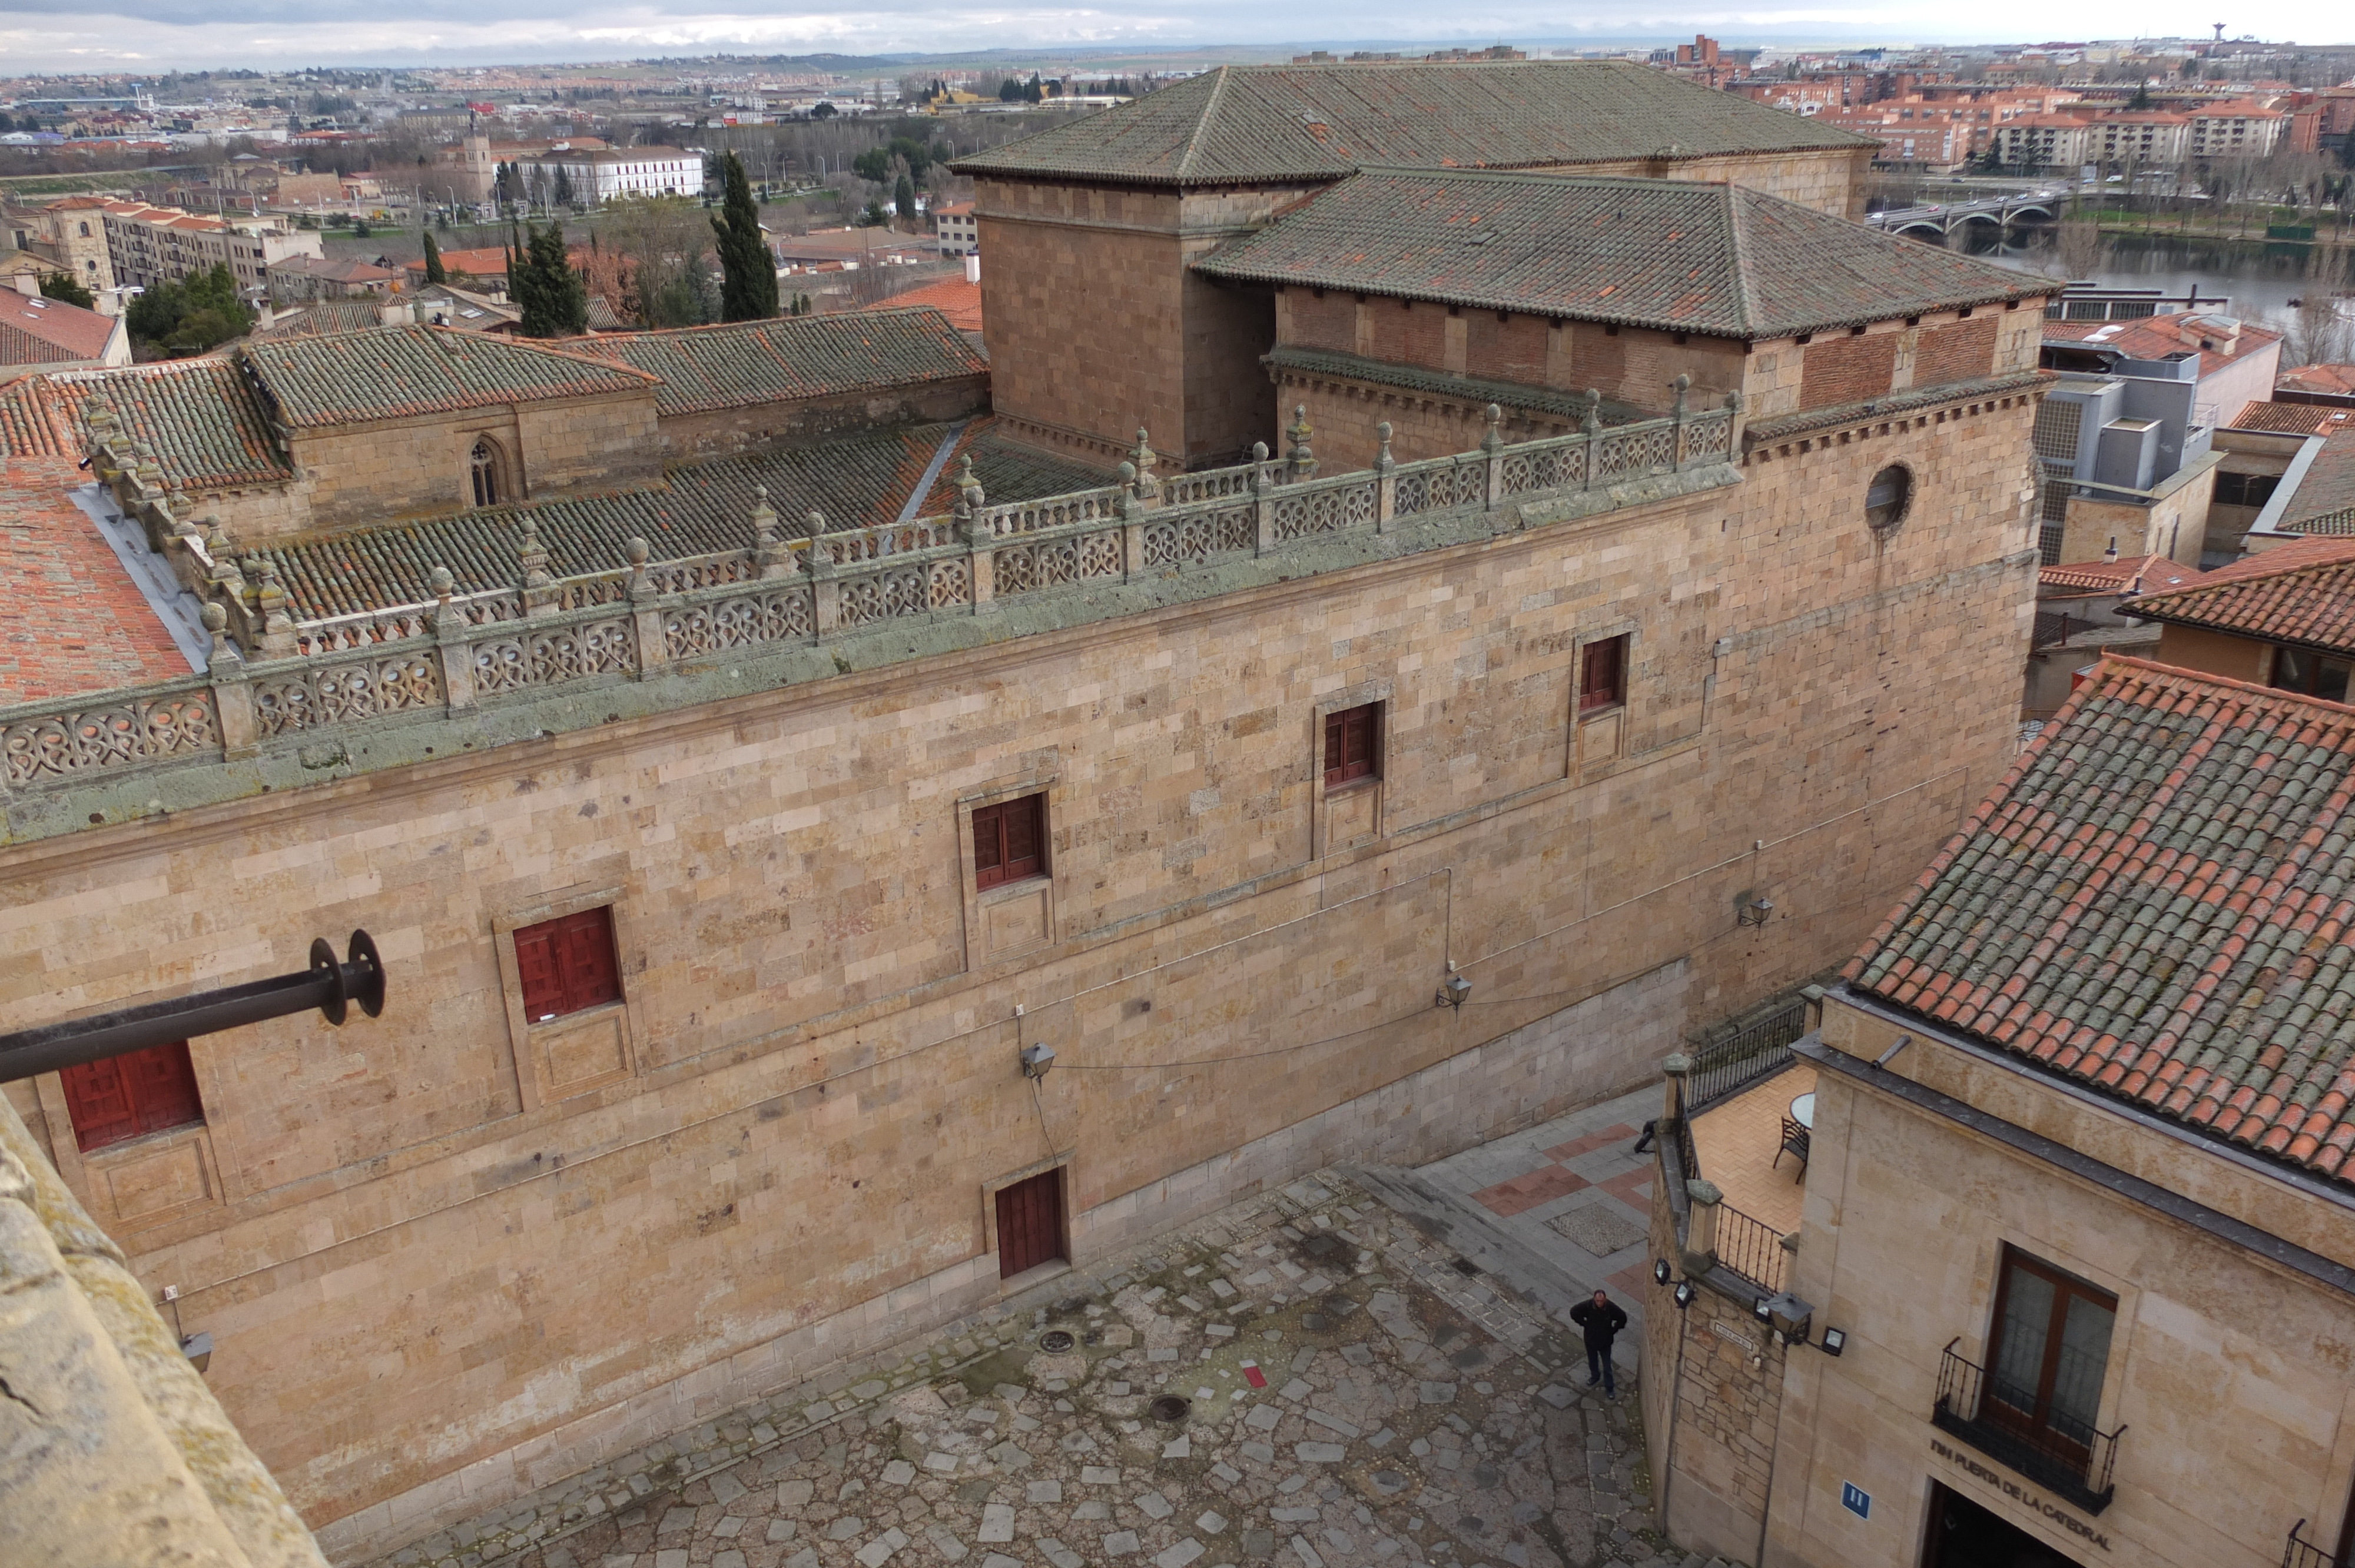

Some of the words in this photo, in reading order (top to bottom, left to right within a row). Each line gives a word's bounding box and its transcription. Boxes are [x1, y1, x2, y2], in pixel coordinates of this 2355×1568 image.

[1955, 1452, 2000, 1489] PUERTA
[2003, 1480, 2021, 1500] DE
[2022, 1491, 2040, 1511] LA
[2043, 1504, 2111, 1551] CATEDRAL
